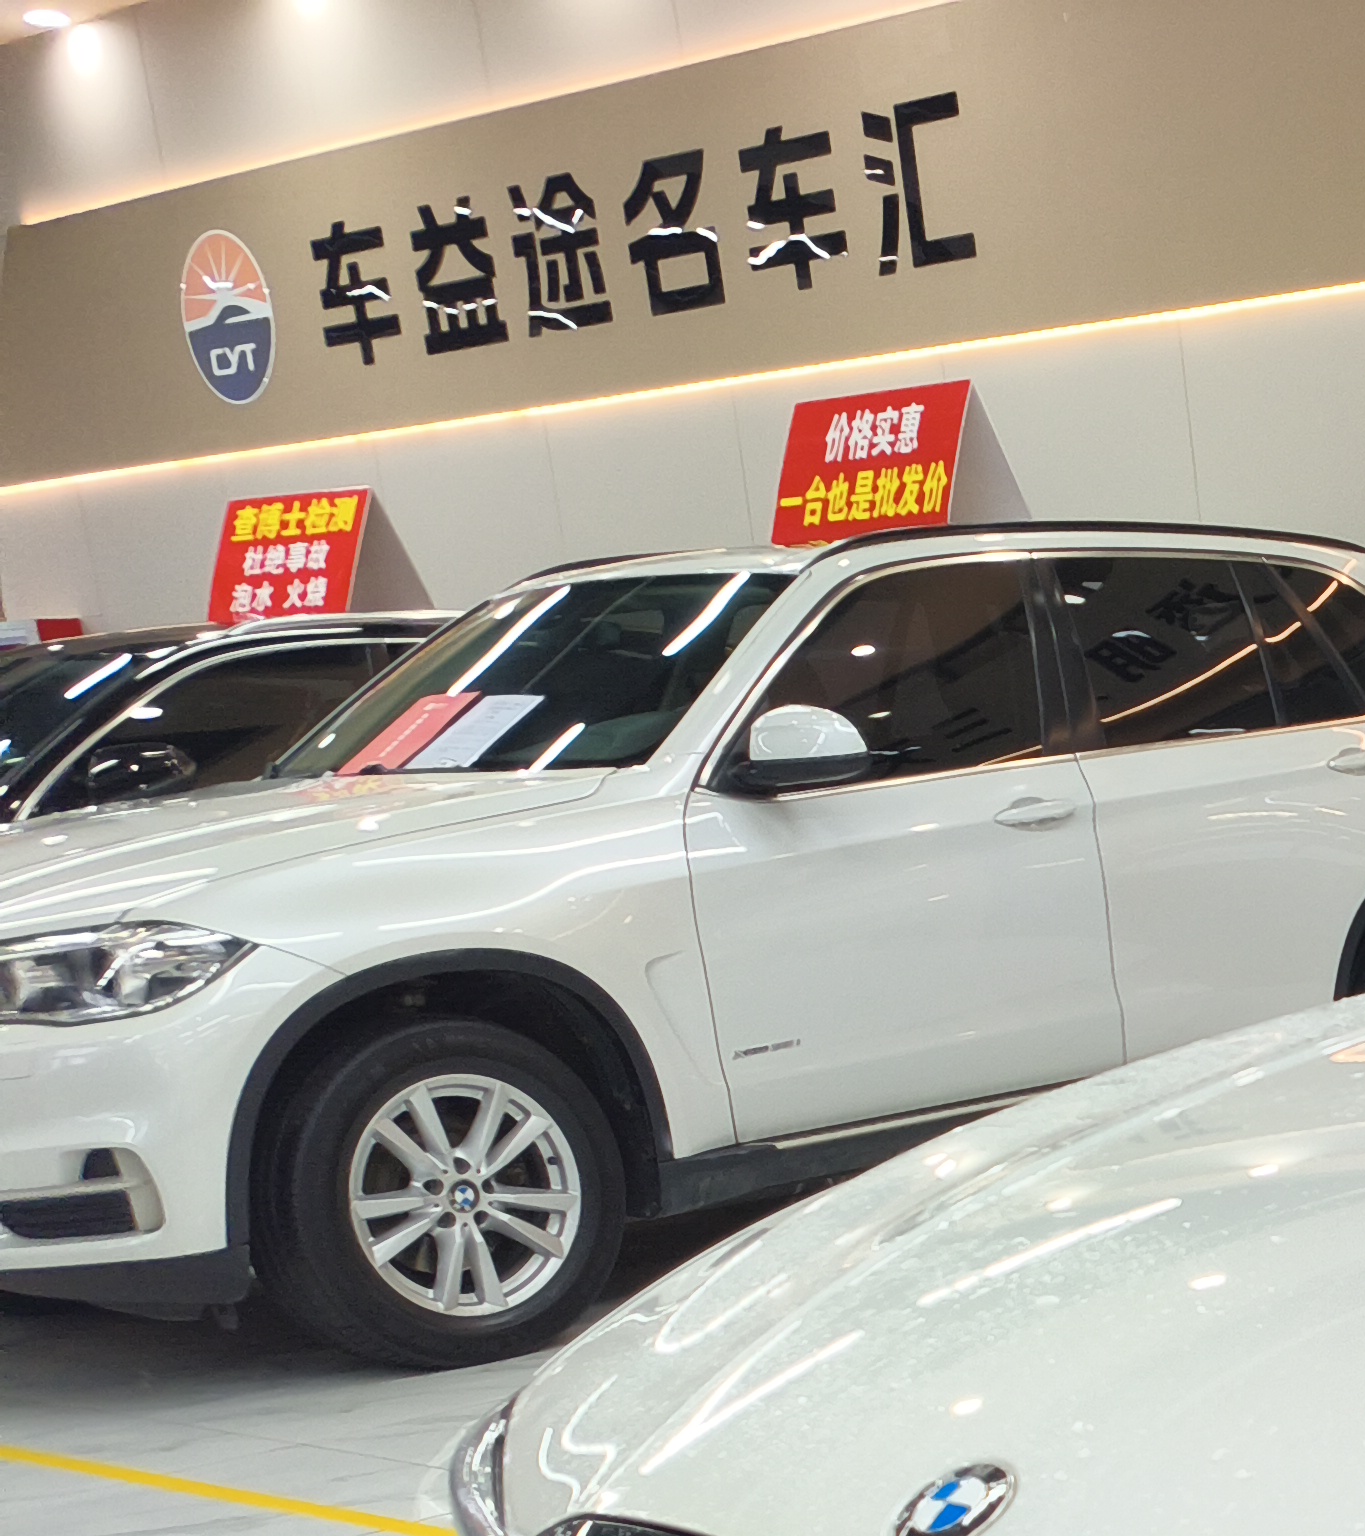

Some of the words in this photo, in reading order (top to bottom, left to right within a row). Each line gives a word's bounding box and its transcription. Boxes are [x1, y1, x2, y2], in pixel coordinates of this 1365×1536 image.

[310, 91, 977, 366] 车益途名车汇
[824, 402, 925, 464] 价格实惠
[230, 495, 359, 543] 查博士检测
[779, 460, 948, 527] 一台也是批发价
[242, 539, 331, 577] 杜绝事故
[229, 580, 275, 613] 泡水
[281, 575, 329, 609] 火烧
